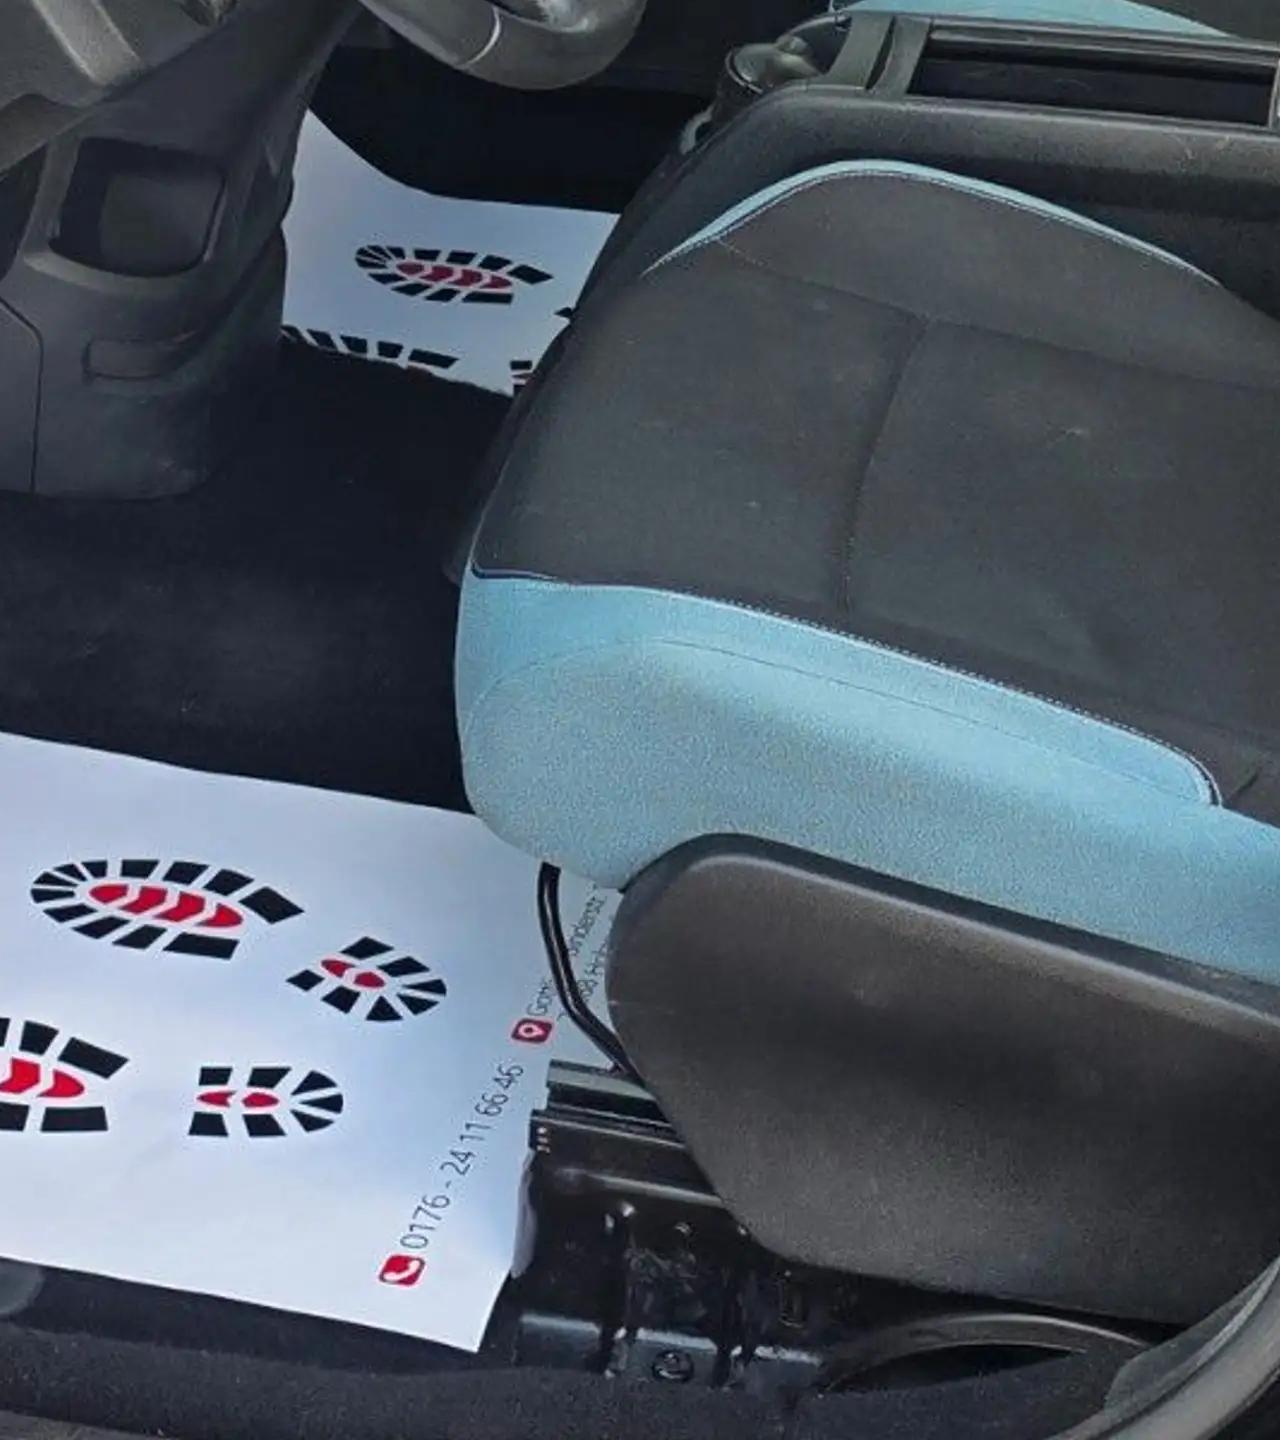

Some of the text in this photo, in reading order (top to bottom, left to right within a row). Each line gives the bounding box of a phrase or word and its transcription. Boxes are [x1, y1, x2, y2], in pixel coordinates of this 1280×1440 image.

[493, 1063, 524, 1090] 46
[474, 1091, 509, 1118] 66
[459, 1122, 492, 1143] 11
[439, 1148, 476, 1177] 24
[399, 1193, 451, 1250] 0176
